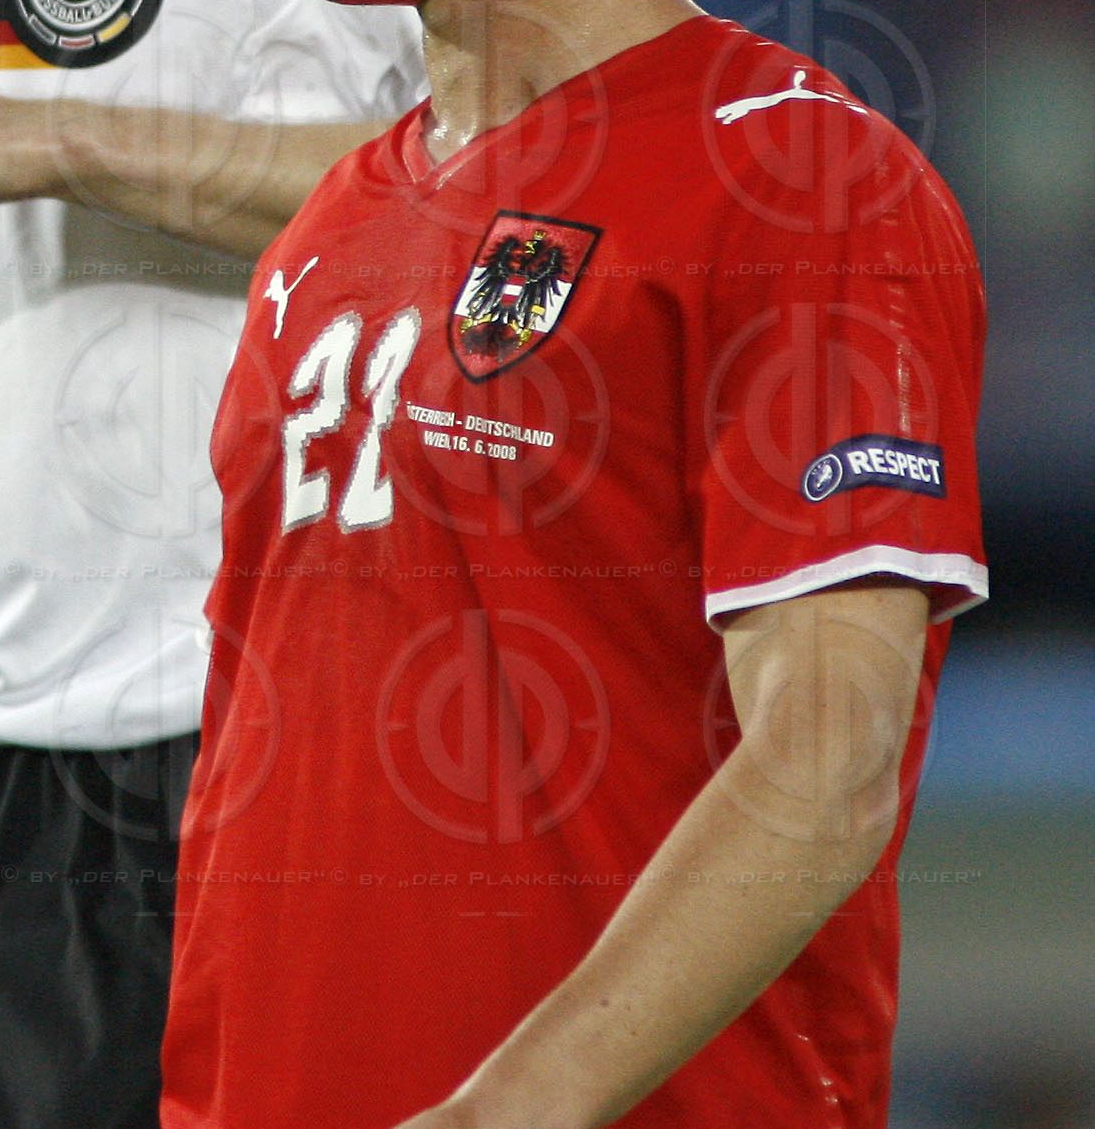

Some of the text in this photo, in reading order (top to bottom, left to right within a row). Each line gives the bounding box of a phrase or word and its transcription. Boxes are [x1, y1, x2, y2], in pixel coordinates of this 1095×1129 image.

[282, 306, 422, 535] 22
[465, 415, 555, 447] DEUTSCHLAND
[846, 448, 941, 485] RESPECT
